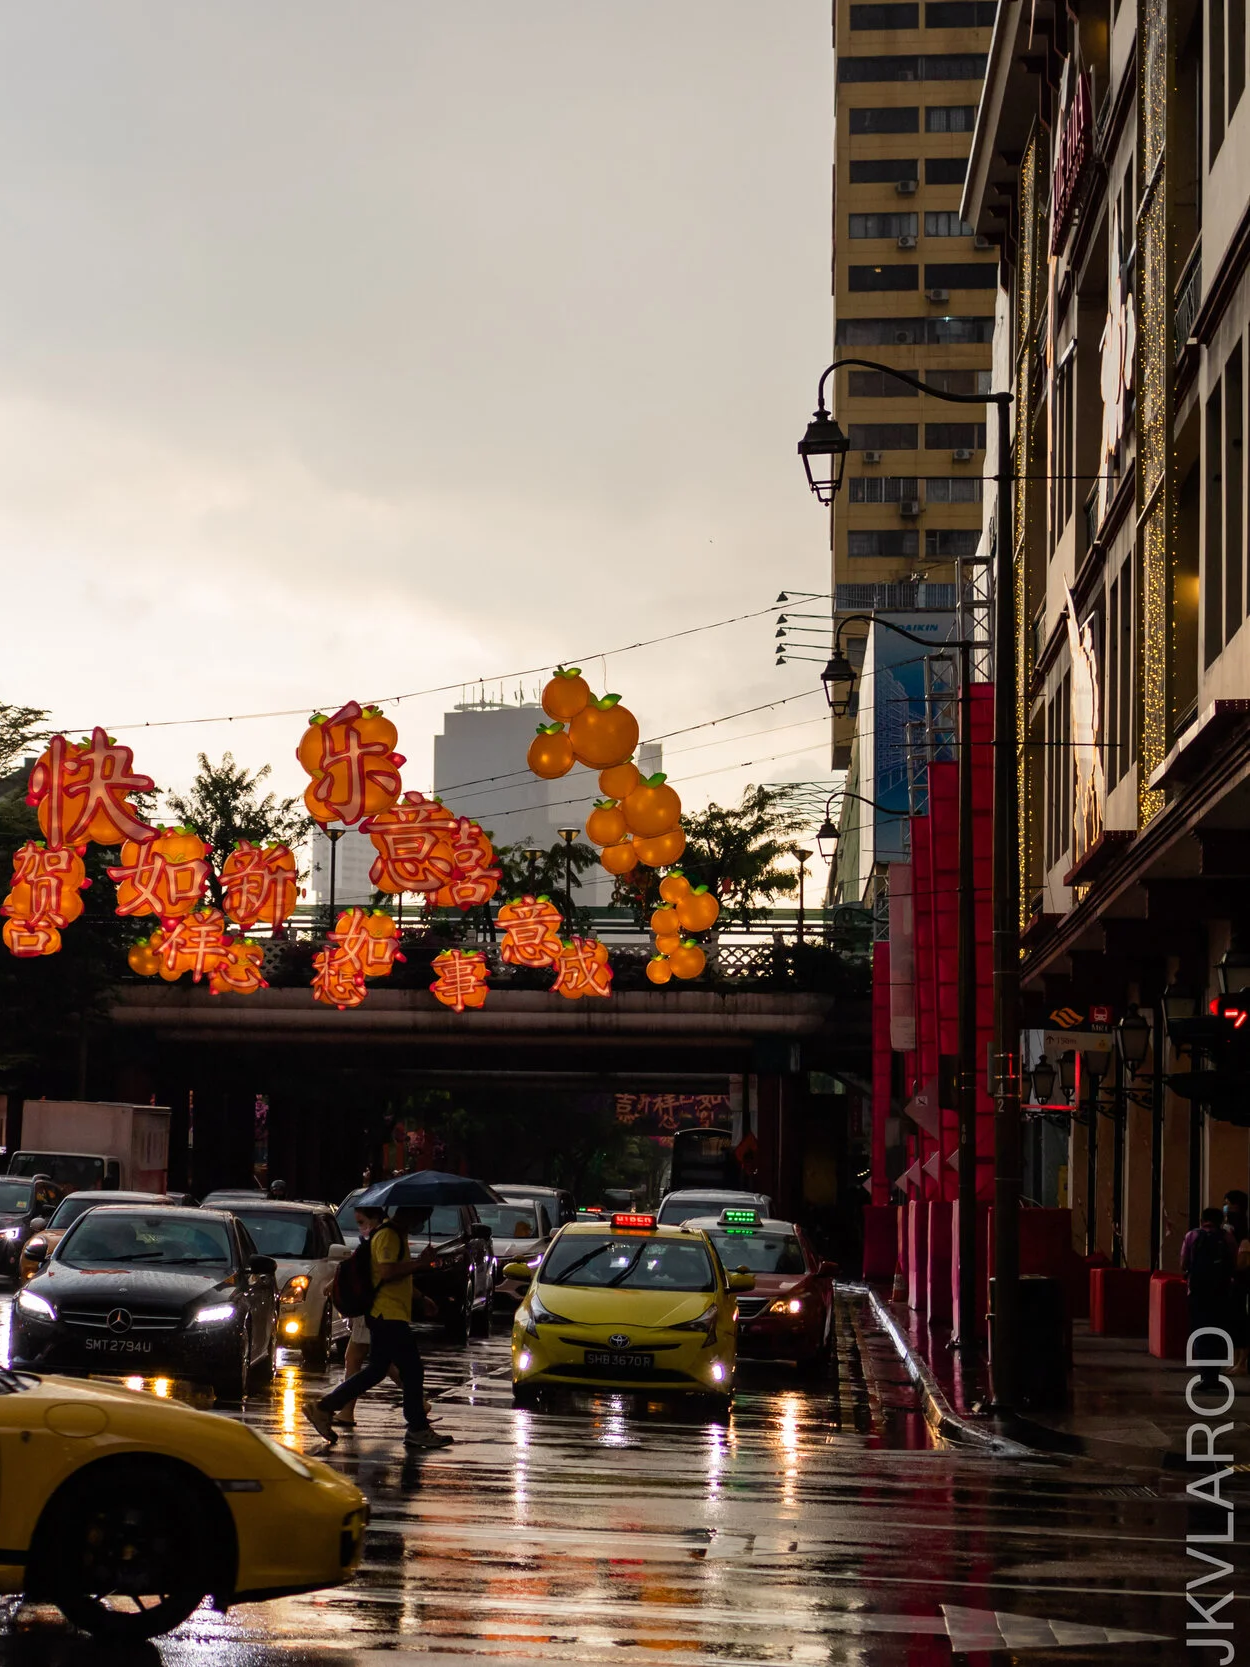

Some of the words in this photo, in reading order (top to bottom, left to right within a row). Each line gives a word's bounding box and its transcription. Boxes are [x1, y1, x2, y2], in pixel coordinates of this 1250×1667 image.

[28, 726, 161, 850] 快
[313, 700, 400, 825] 乐
[10, 840, 74, 928] 贺
[218, 839, 296, 932] 新
[107, 841, 212, 916] 如
[359, 791, 458, 892] 意
[153, 906, 232, 983] 祥
[326, 906, 400, 969] 如
[494, 896, 563, 967] 意
[431, 950, 487, 1013] 事
[549, 936, 612, 998] 成
